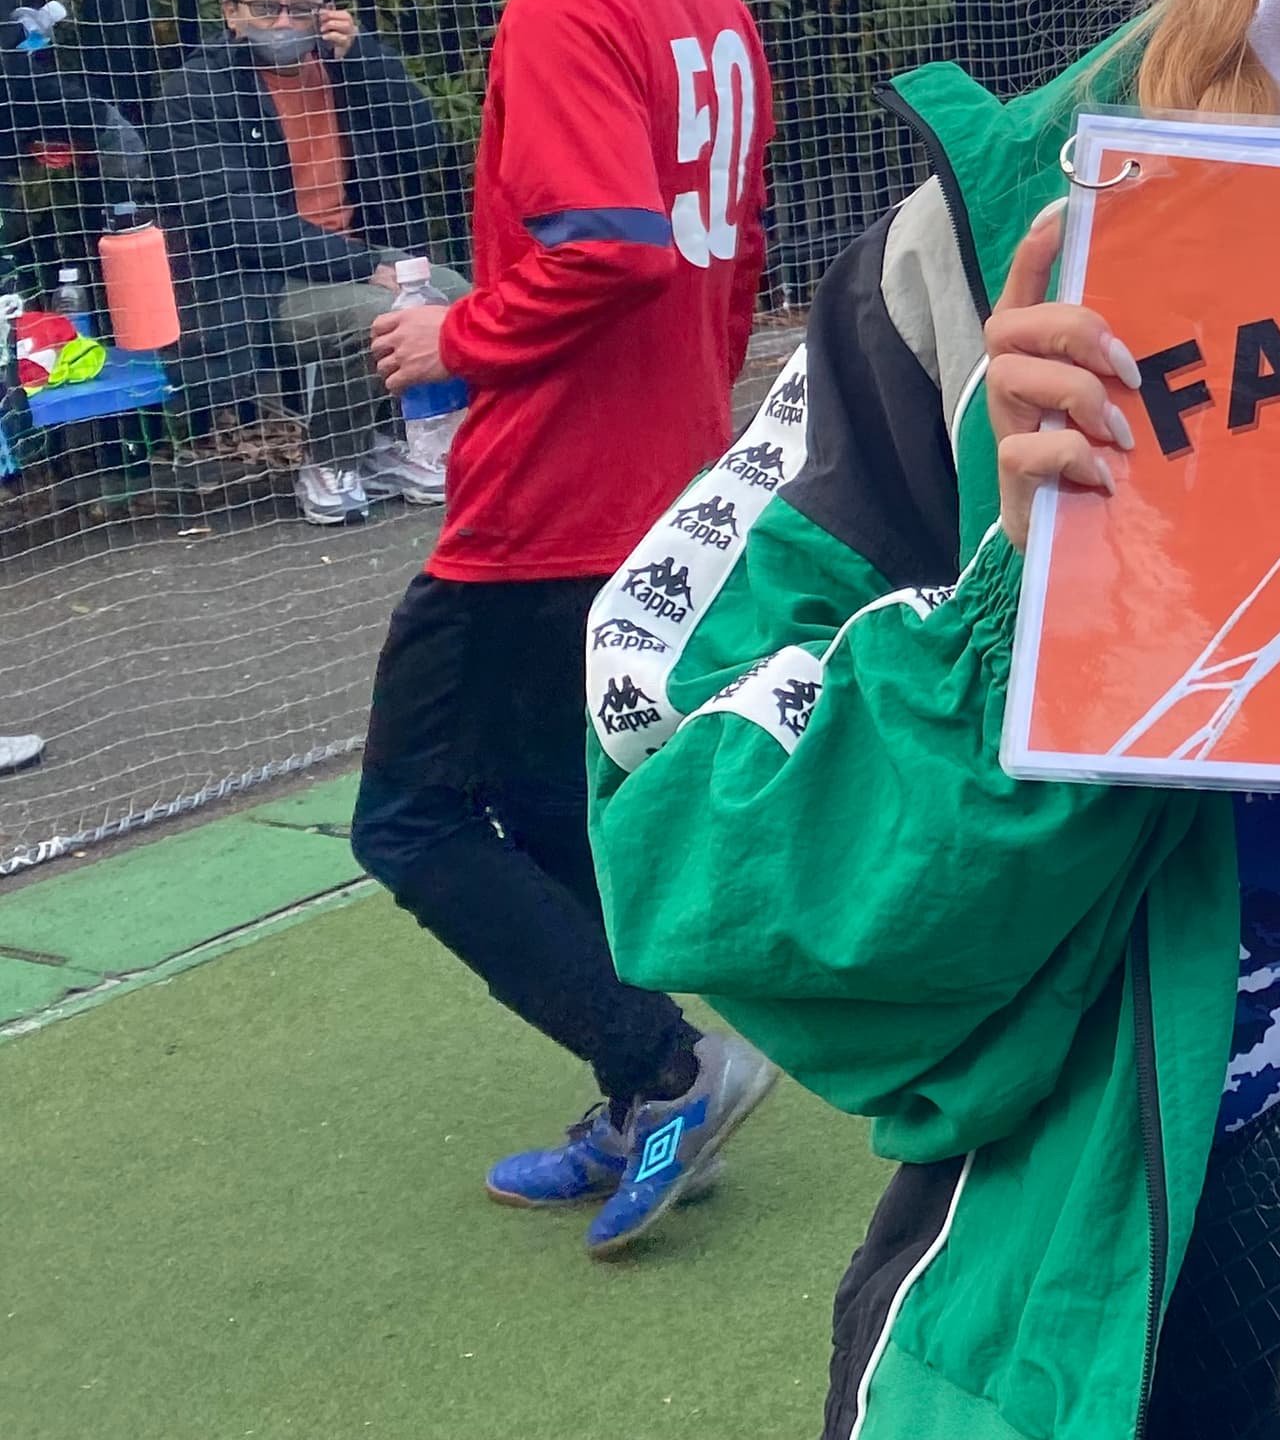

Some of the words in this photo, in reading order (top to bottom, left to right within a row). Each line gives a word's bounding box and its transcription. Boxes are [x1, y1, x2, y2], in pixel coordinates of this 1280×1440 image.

[670, 29, 755, 268] 50
[765, 399, 803, 426] Kappa
[719, 455, 779, 492] Kappa
[669, 510, 732, 551] Kappa
[620, 572, 688, 624] Kappa
[592, 629, 667, 653] Kappa
[602, 705, 661, 735] Kappa
